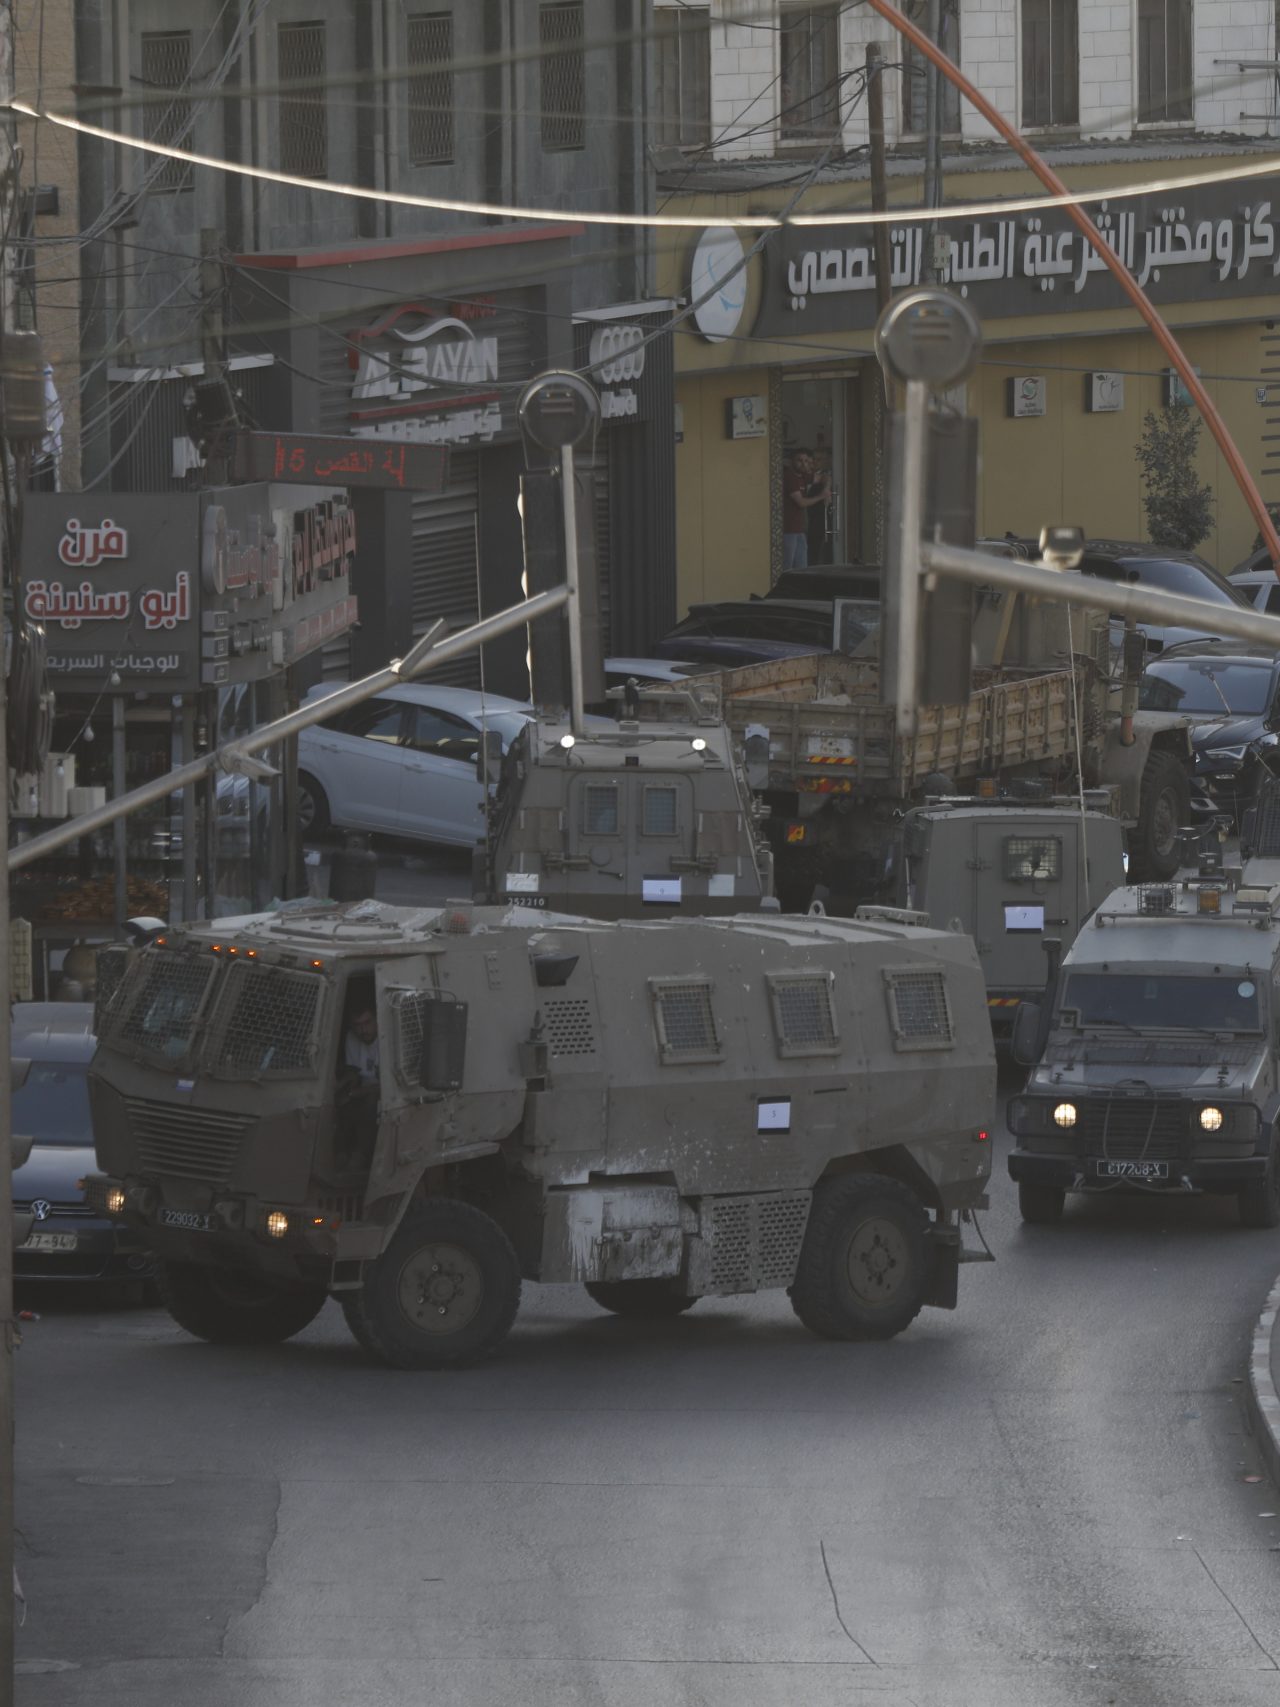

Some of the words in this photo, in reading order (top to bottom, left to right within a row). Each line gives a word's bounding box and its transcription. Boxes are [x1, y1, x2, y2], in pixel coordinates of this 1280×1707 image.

[788, 227, 923, 311] التصصي
[1023, 199, 1135, 294] الشرعية
[602, 388, 638, 419] Audi
[58, 518, 128, 567] فرن
[24, 580, 130, 629] سنينة
[140, 571, 191, 630] أبو
[46, 654, 104, 672] السريع
[110, 653, 179, 673] للوجبات
